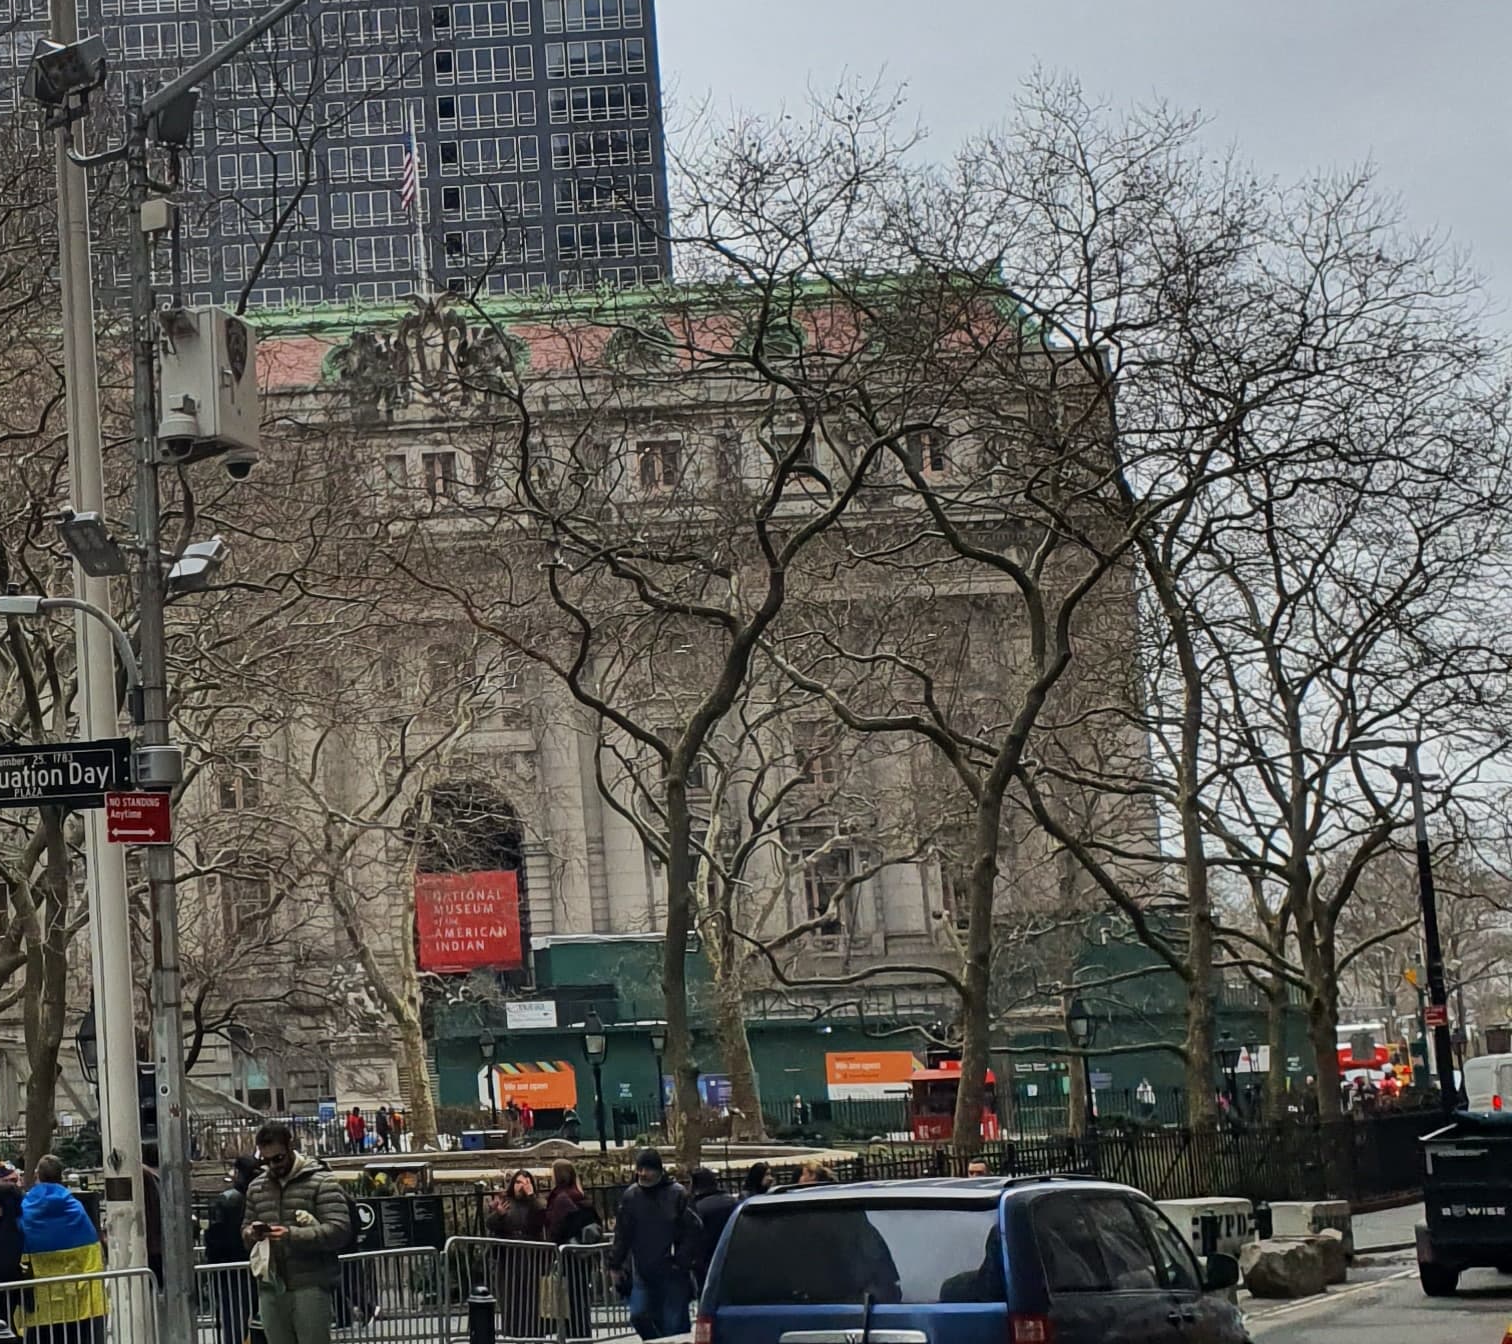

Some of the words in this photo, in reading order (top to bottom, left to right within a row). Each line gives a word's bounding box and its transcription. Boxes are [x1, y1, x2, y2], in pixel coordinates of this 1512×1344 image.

[52, 752, 74, 764] 1783
[69, 762, 110, 788] Day
[13, 786, 43, 798] PLAZA
[109, 797, 121, 808] NO
[122, 797, 160, 808] STANDING
[110, 808, 142, 821] Anytime
[432, 889, 504, 902] NATIONAL
[433, 903, 494, 915] MUSEUM
[435, 926, 507, 938] AMERICAN
[435, 939, 486, 952] INDIAN
